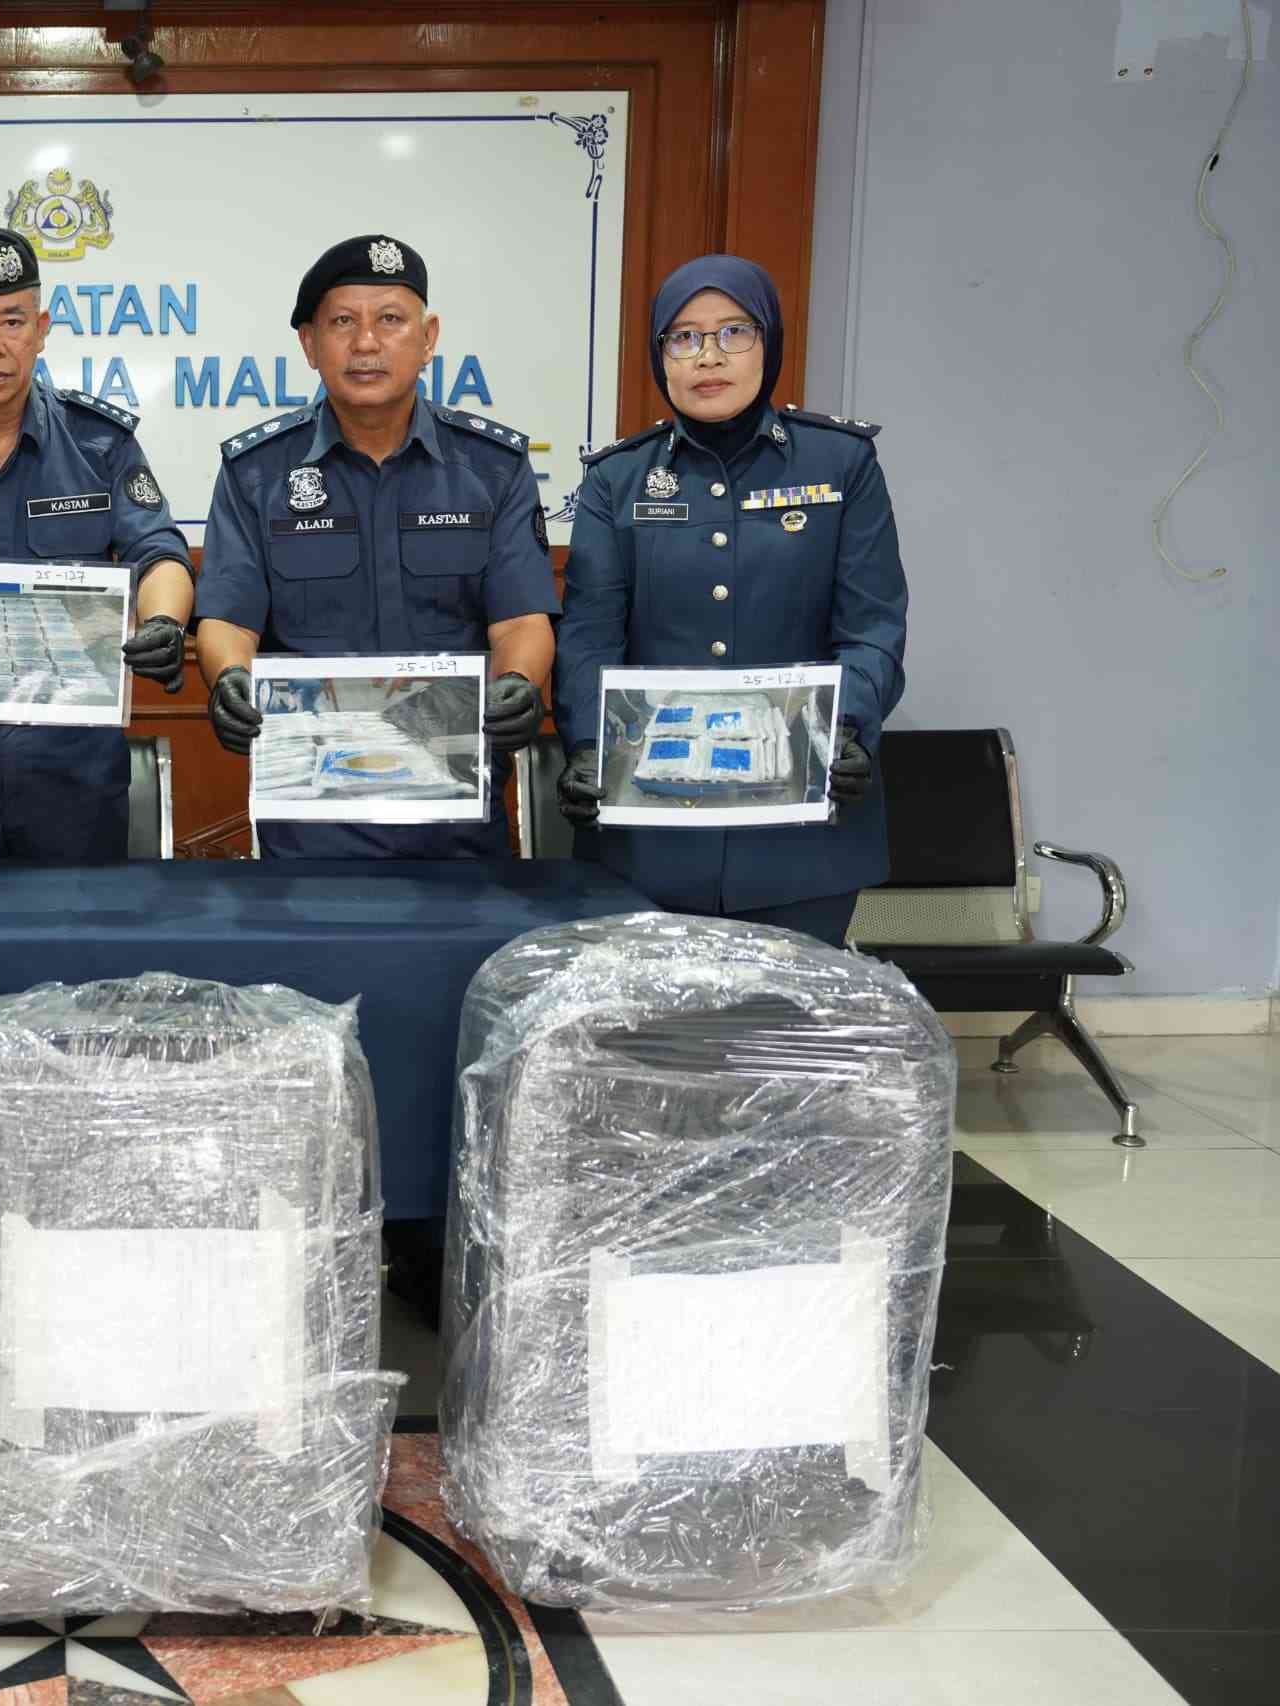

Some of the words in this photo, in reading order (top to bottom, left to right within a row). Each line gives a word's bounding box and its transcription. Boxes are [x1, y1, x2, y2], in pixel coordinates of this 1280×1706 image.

[51, 500, 90, 512] KASTAM
[295, 518, 335, 530] ALADI
[418, 514, 470, 525] KASTAM
[396, 660, 458, 673] 25-129
